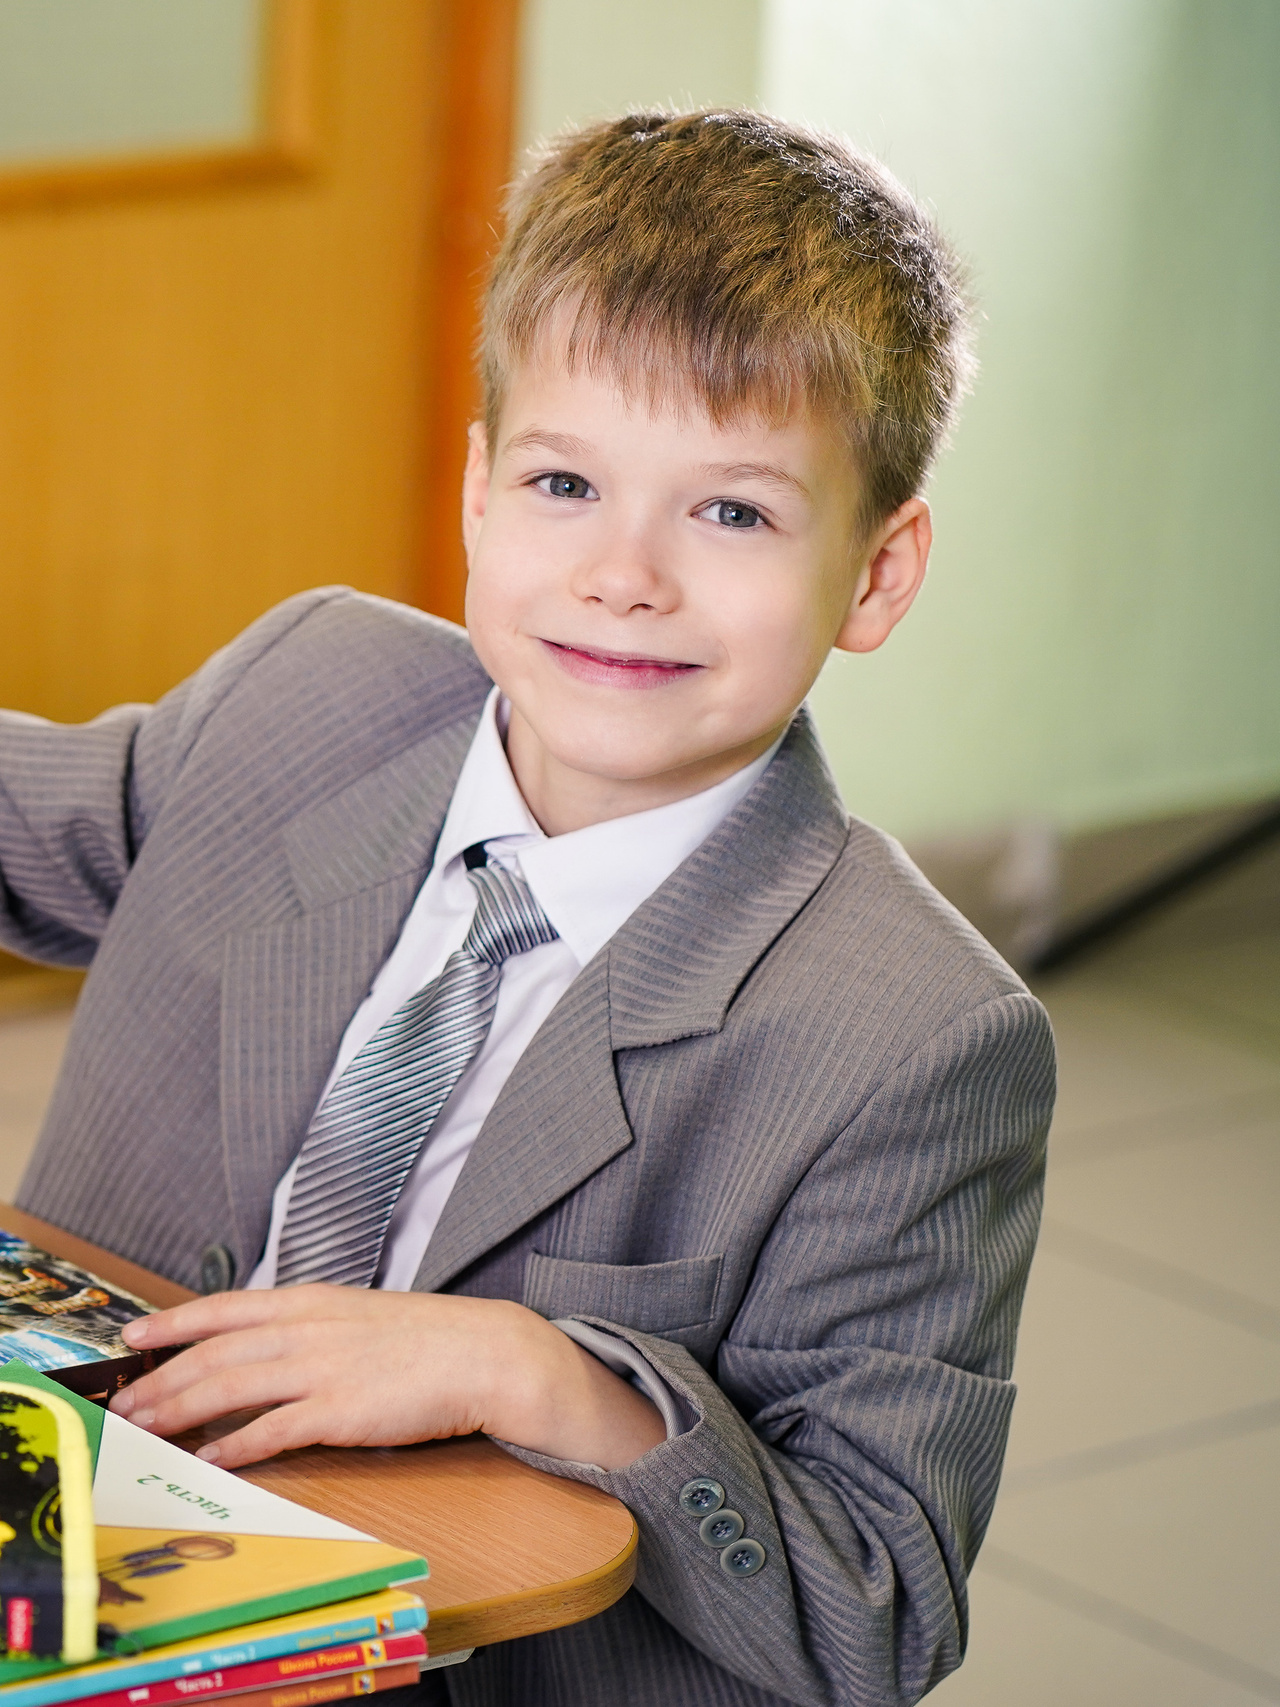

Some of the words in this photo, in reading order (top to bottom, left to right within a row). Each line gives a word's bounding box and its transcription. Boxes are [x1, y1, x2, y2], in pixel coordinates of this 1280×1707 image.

[136, 1473, 163, 1486] 2
[163, 1481, 231, 1521] Часть
[278, 1656, 318, 1675] Школа
[317, 1650, 359, 1668] России
[174, 1676, 214, 1694] Часть
